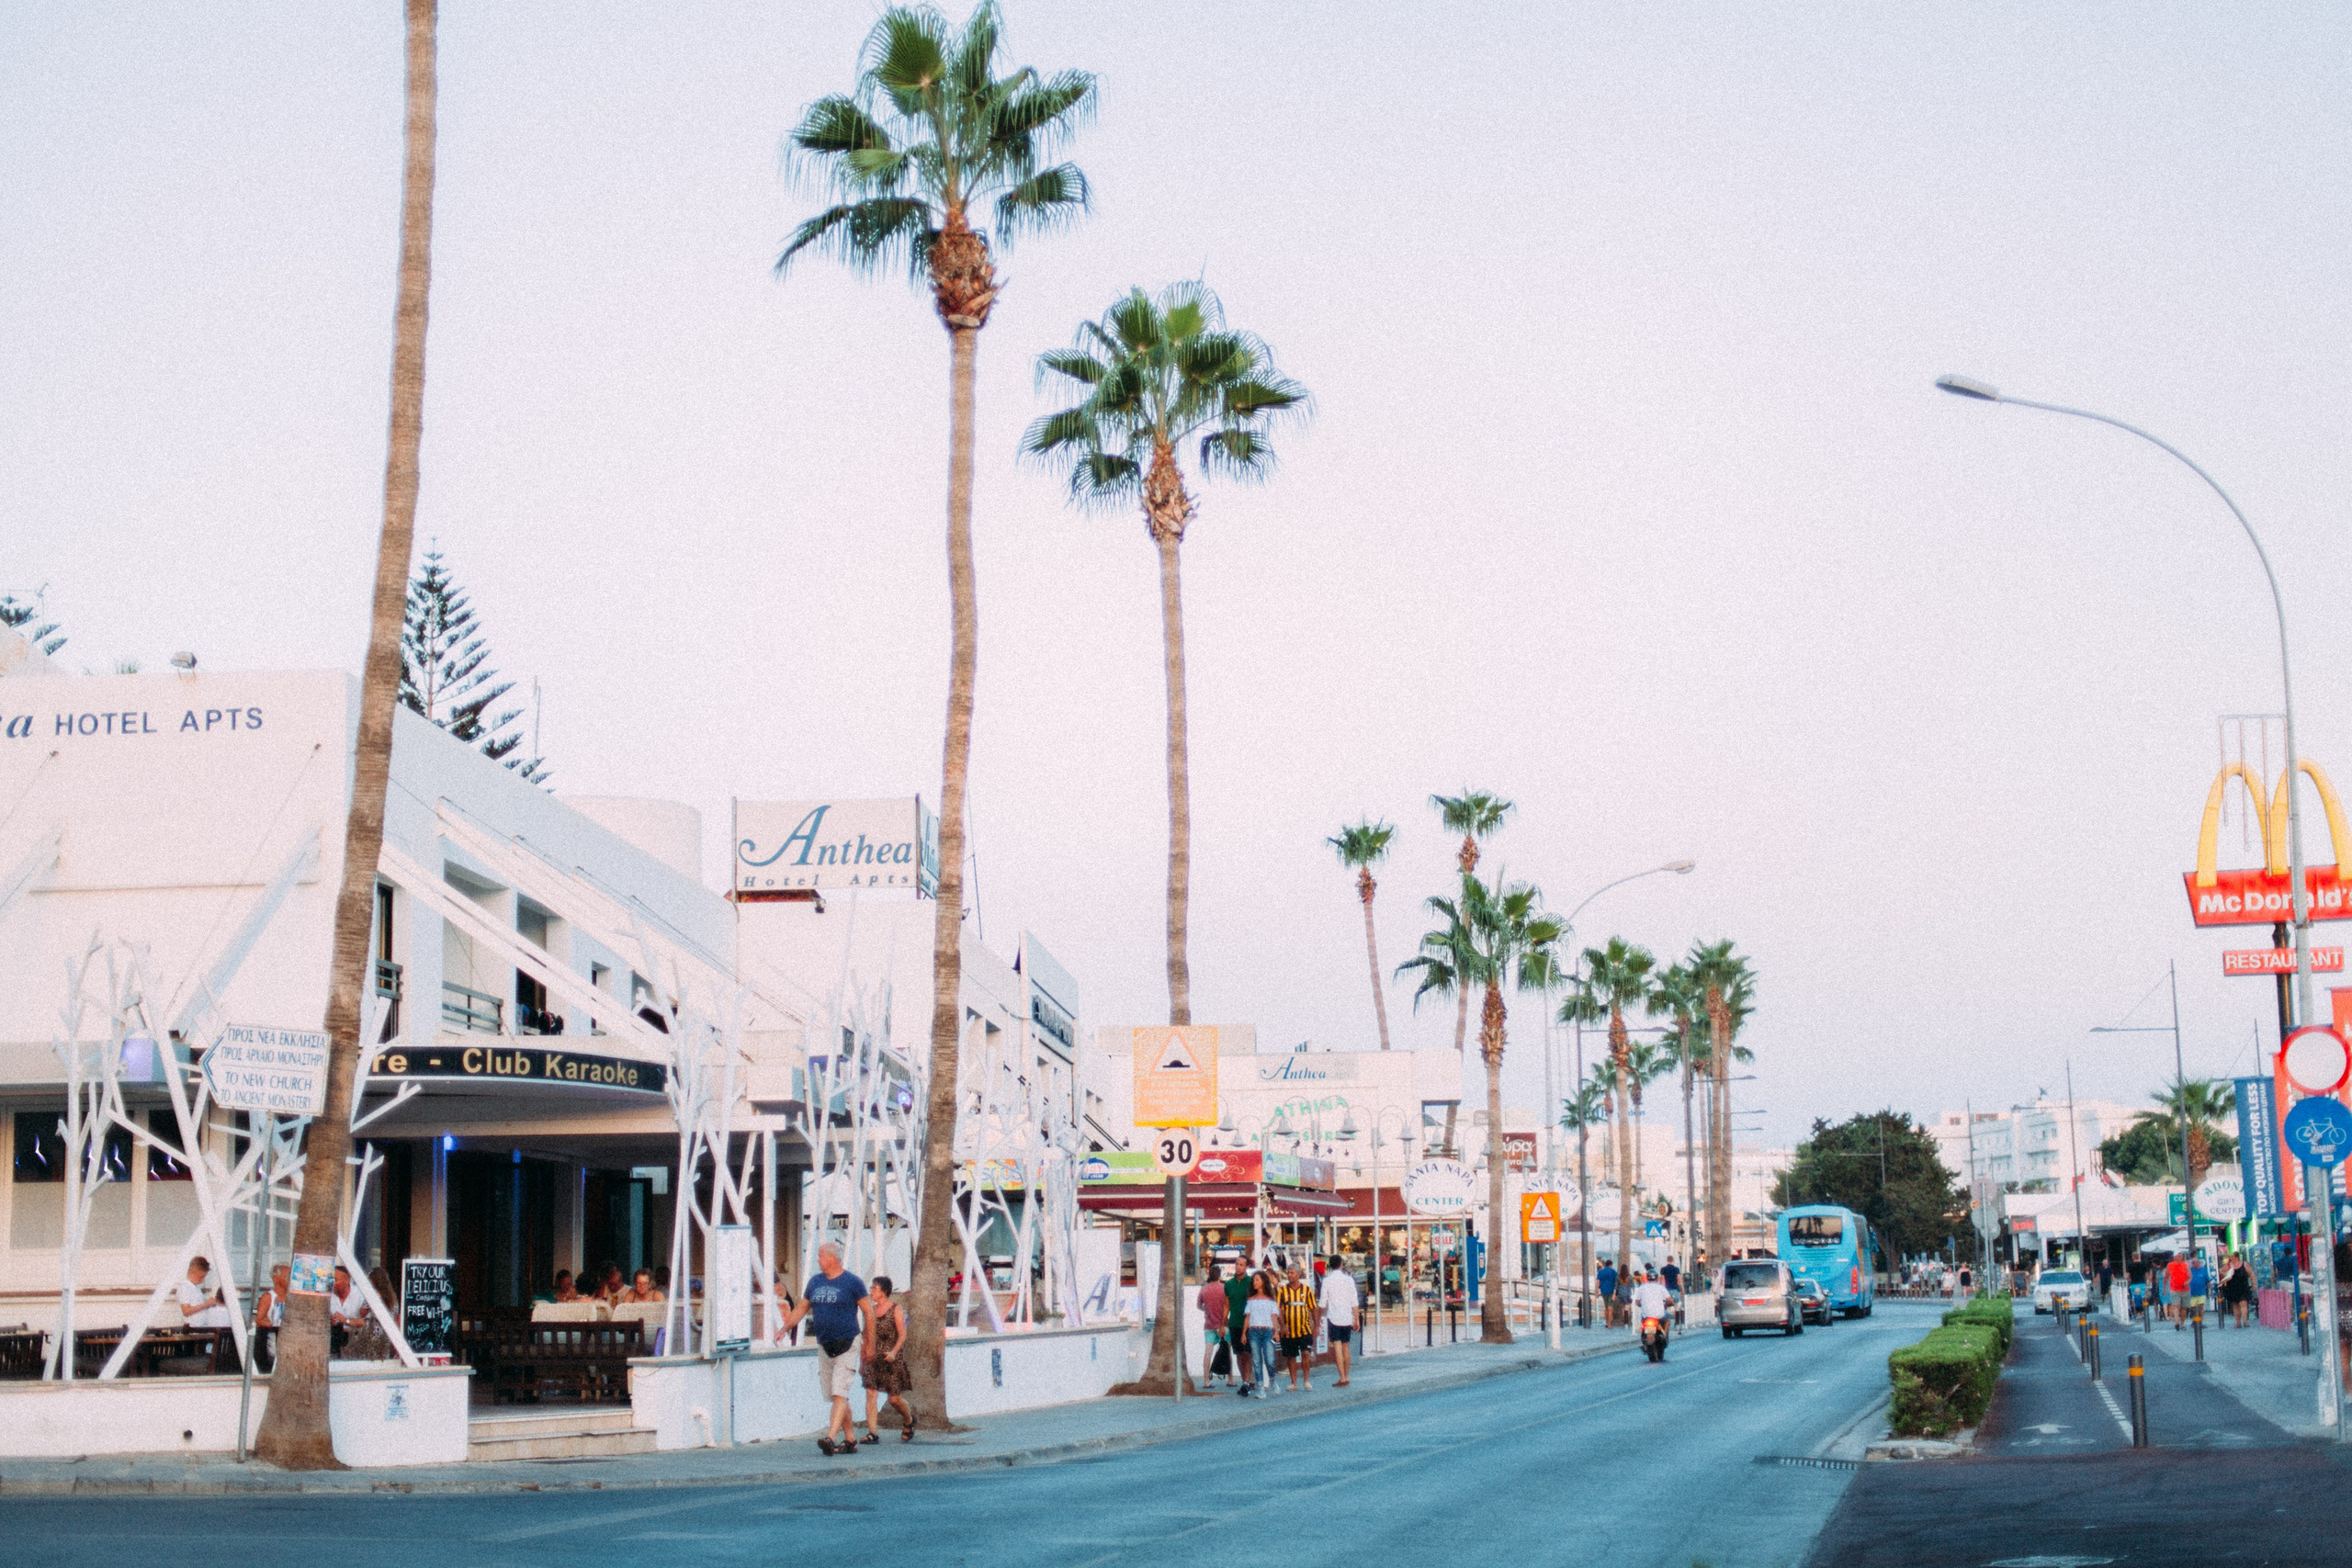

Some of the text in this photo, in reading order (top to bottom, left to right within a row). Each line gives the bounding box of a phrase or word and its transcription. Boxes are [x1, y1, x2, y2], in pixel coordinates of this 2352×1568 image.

[0, 707, 264, 739] a HOTEL APTS
[738, 805, 912, 867] Anthea
[743, 874, 909, 887] Hotel Apts
[2225, 950, 2342, 969] RESTAUANT
[462, 1048, 531, 1076] Club
[545, 1055, 639, 1086] Karaoke
[1260, 1056, 1326, 1080] Anthea
[225, 1071, 312, 1091] TO NEW CHURCH
[1160, 1139, 1193, 1164] 30
[2247, 1083, 2267, 1214] TOP QUALITY FOR LESS
[1404, 1162, 1475, 1189] SANTA NAPA
[1415, 1197, 1464, 1206] CENTER
[411, 1266, 447, 1279] TRY OUR
[407, 1305, 425, 1316] FREE
